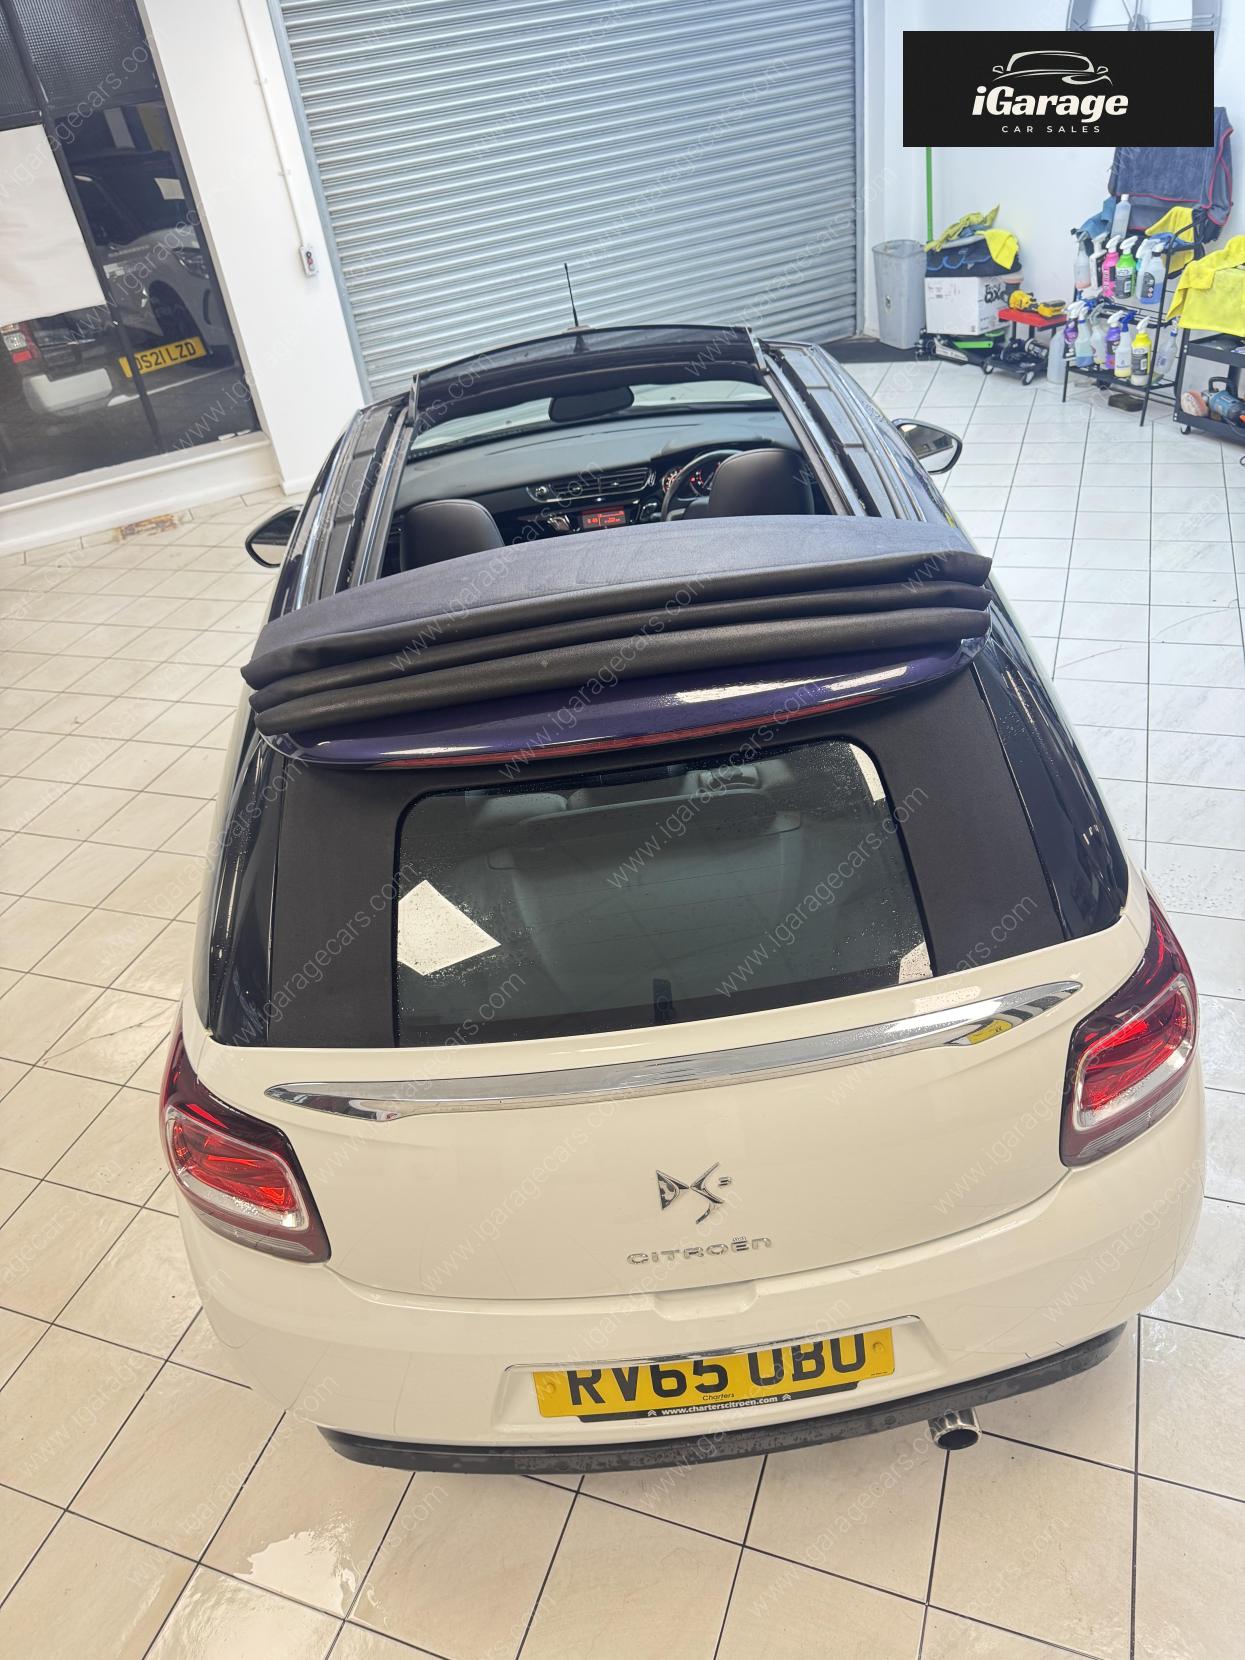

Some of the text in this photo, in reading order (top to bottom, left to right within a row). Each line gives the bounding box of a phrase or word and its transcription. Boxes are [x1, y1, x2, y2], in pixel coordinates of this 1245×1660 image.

[165, 342, 197, 362] LZD
[567, 1360, 729, 1405] RV65
[661, 1396, 778, 1415] www.charterscitroen.com
[702, 1392, 735, 1402] Charters
